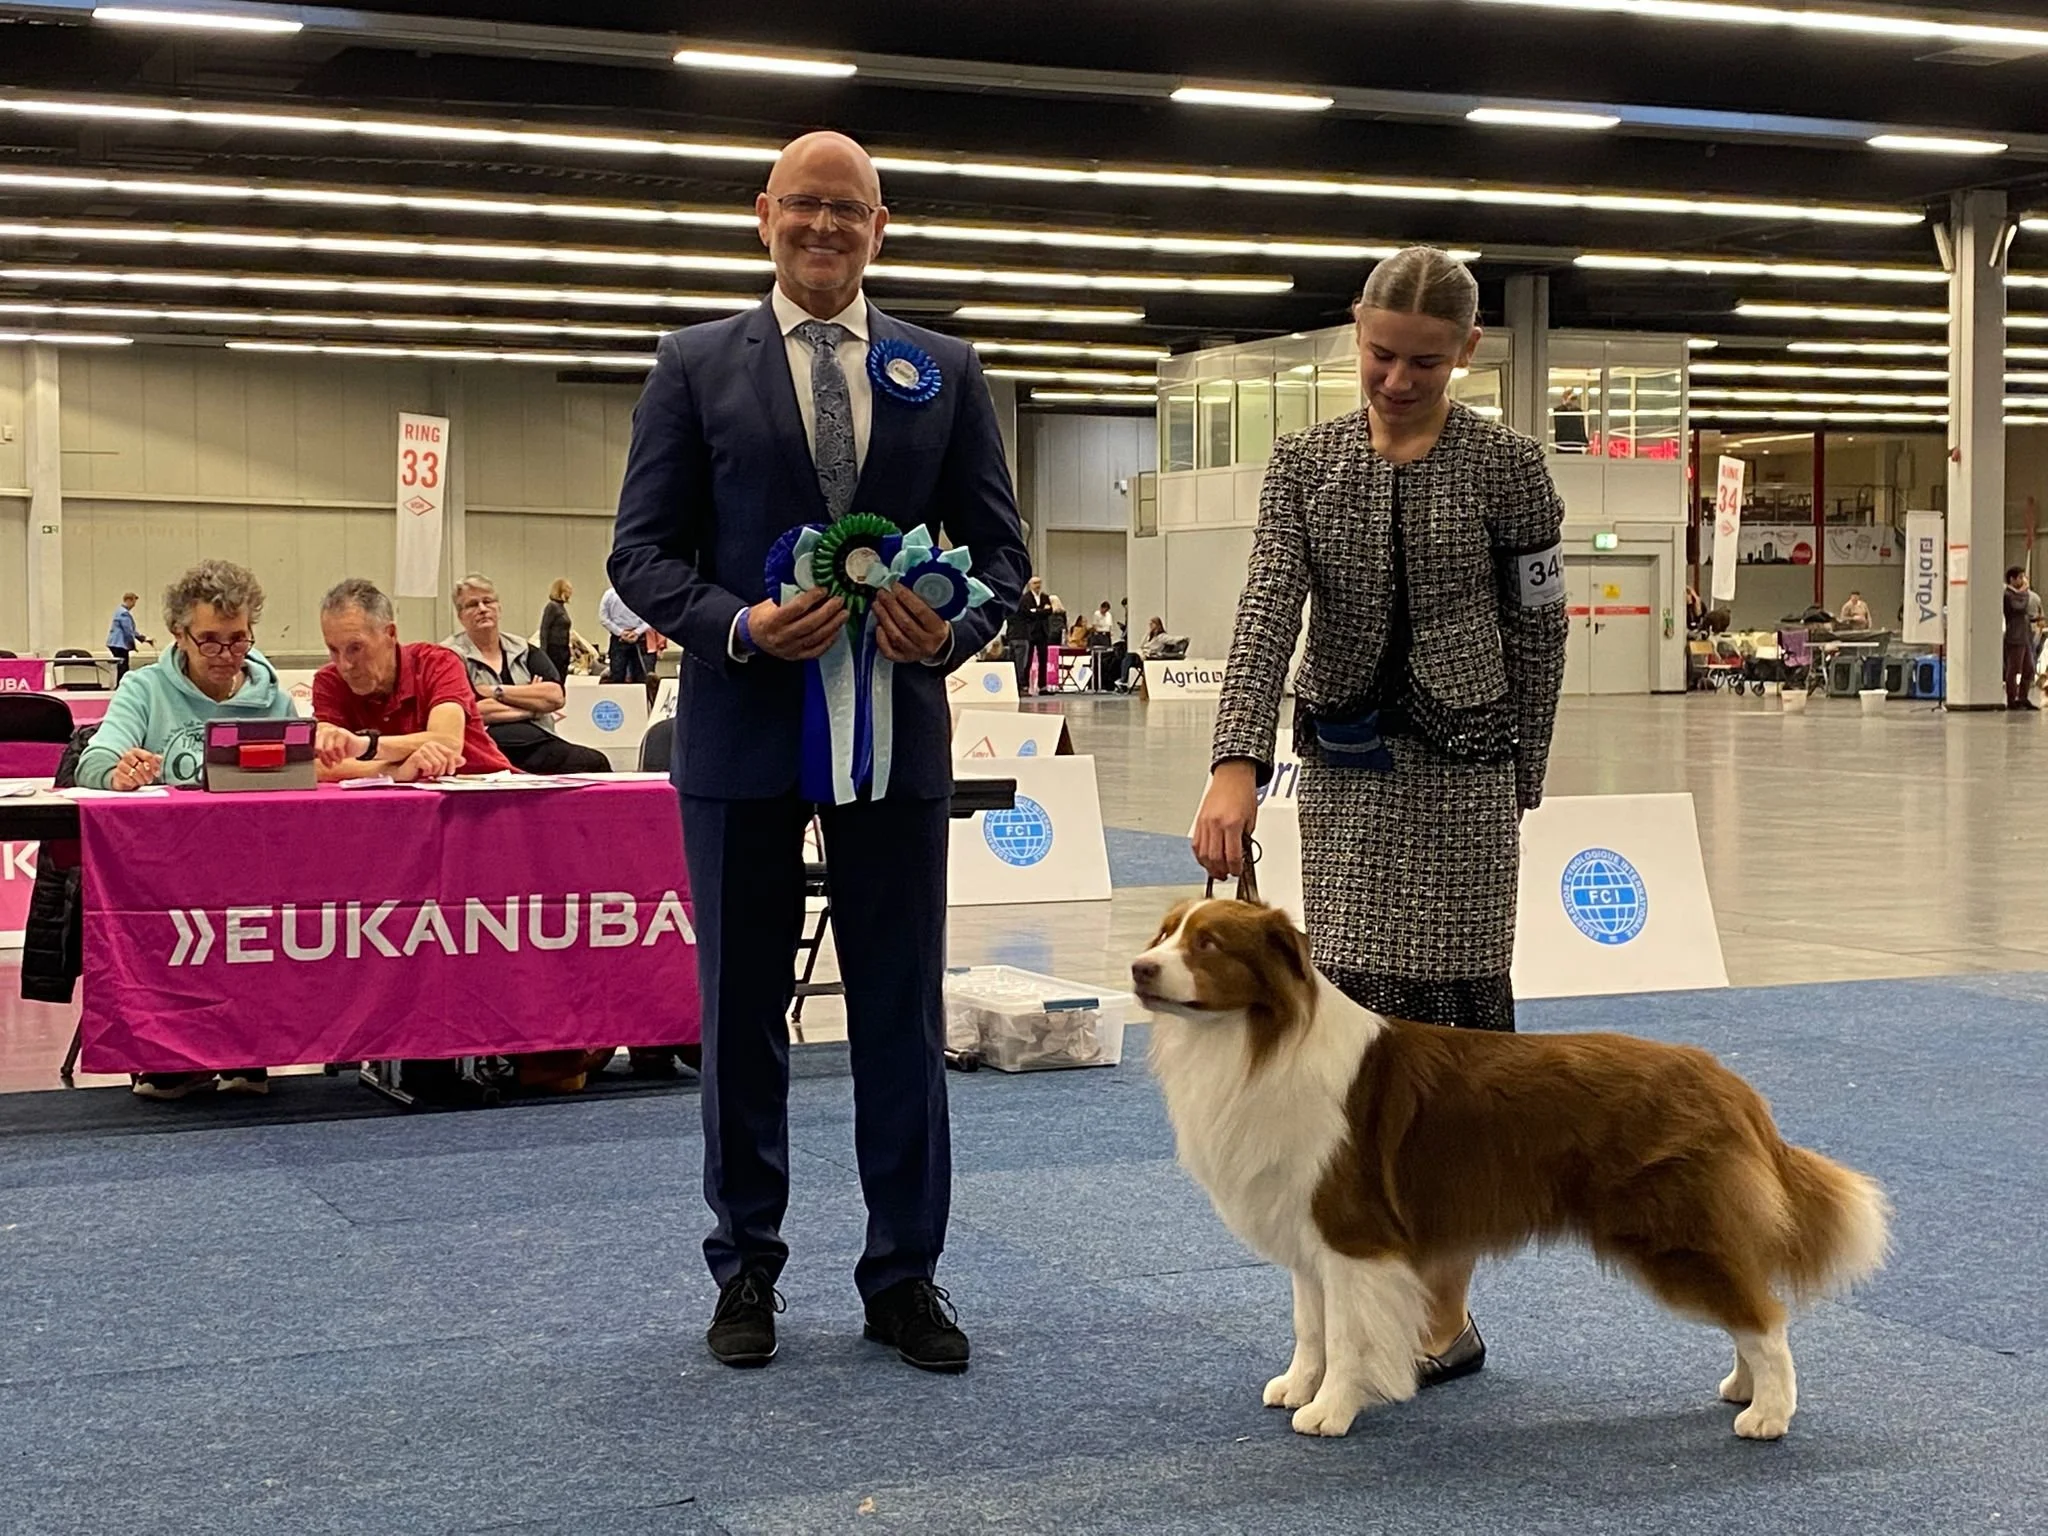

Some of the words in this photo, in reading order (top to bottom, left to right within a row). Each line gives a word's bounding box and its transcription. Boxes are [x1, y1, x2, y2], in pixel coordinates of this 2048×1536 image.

[405, 424, 440, 443] RING
[402, 449, 438, 488] 33
[1719, 485, 1738, 515] 34
[1162, 667, 1211, 687] Agria
[1006, 825, 1031, 836] FCI
[1589, 890, 1620, 904] FCI
[226, 890, 697, 963] EUKANUBA
